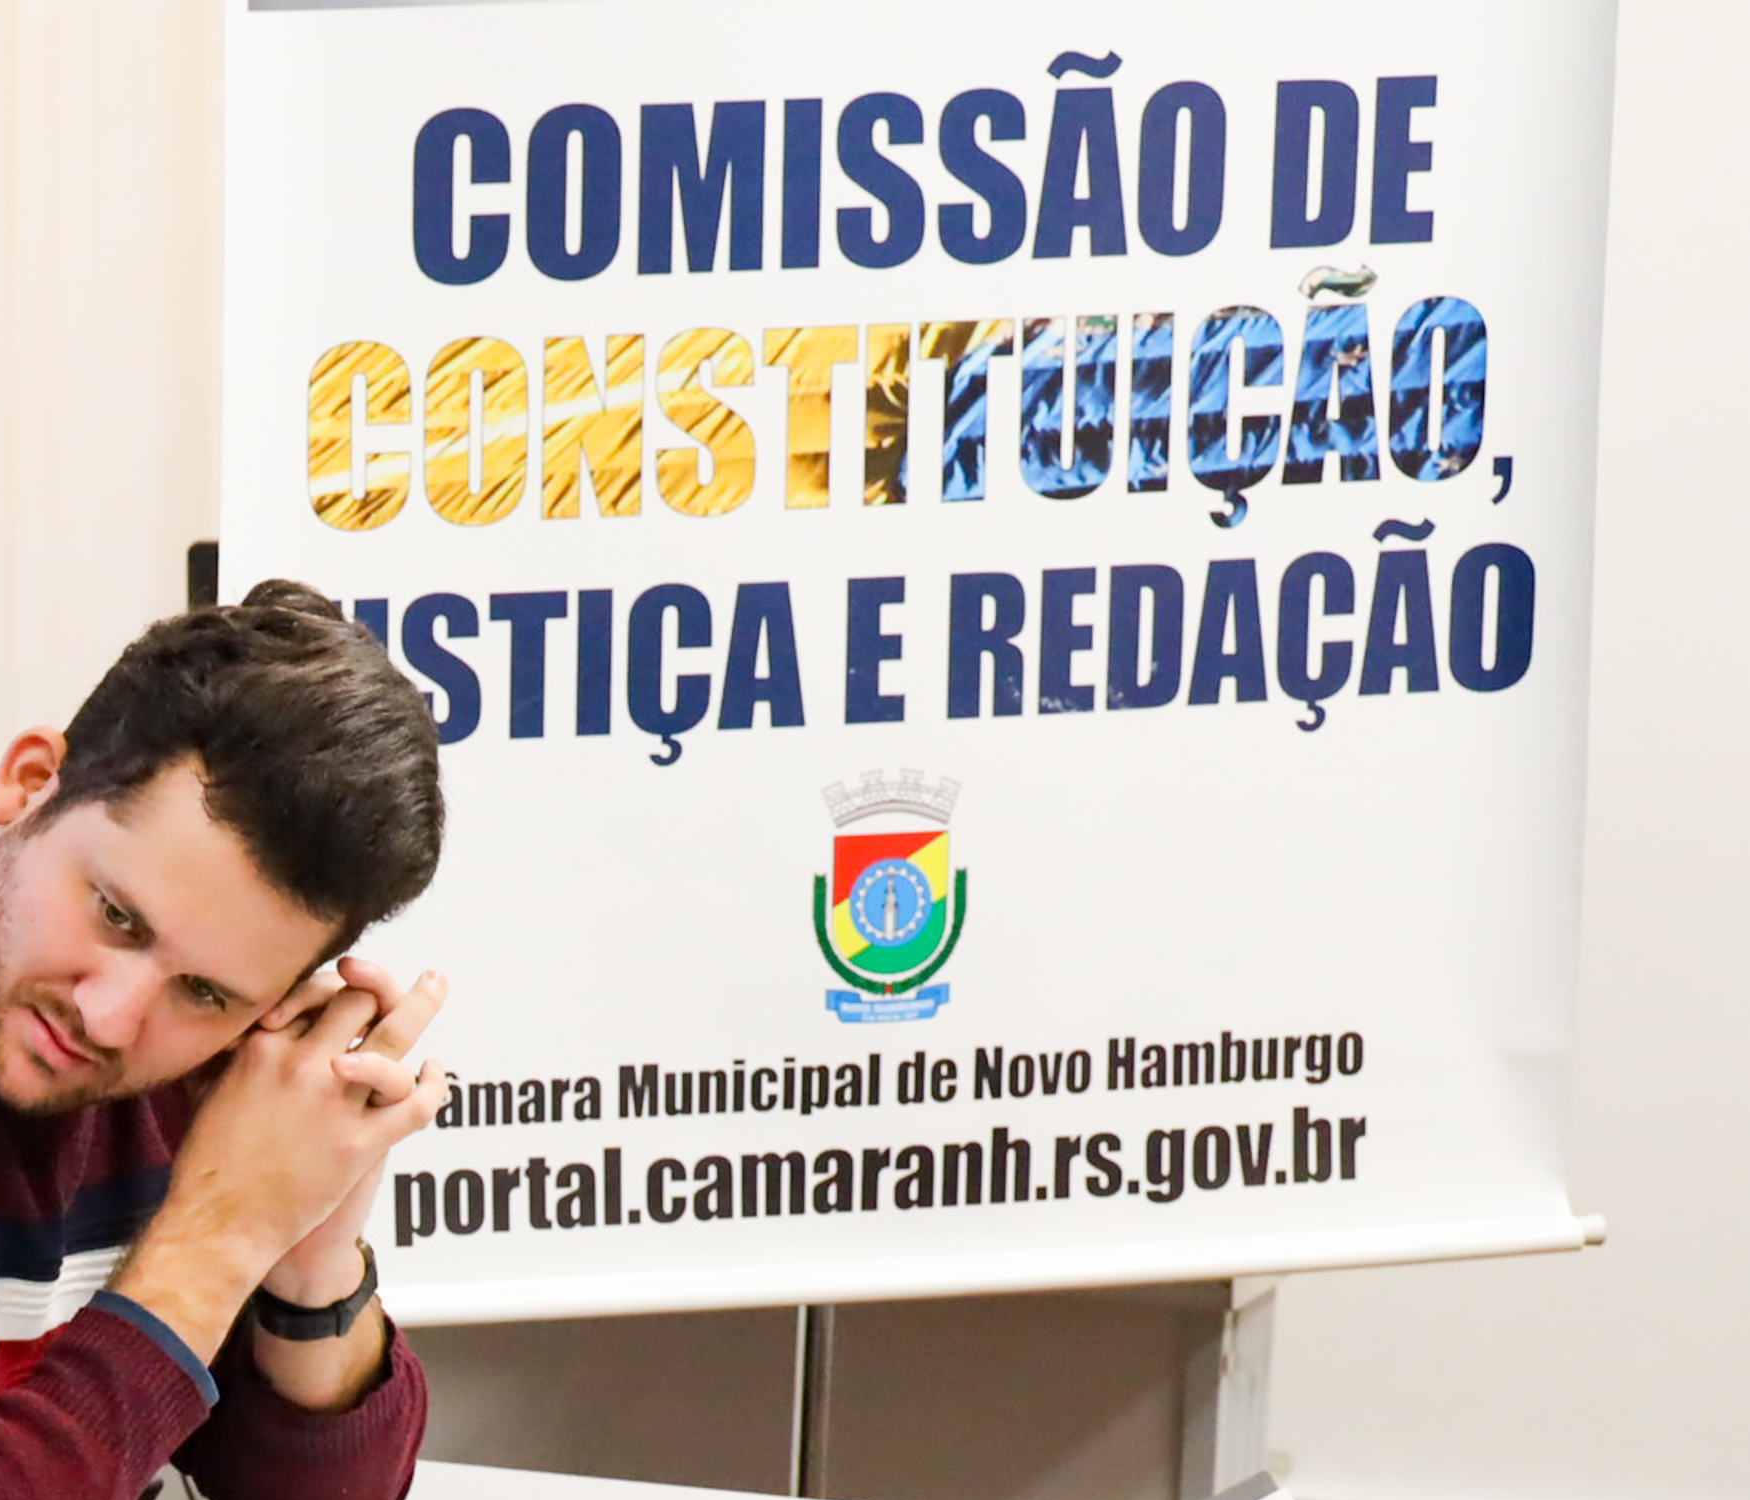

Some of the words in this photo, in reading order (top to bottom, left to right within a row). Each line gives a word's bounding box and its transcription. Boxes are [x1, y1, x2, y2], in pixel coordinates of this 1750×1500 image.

[412, 51, 1227, 286] COMISSÃO
[1269, 75, 1438, 249] DE
[307, 264, 1514, 531] CONSTITUIÇÃO,
[332, 581, 806, 767] STIÇA
[844, 576, 906, 725] E
[946, 518, 1536, 732] REDAÇÃO
[394, 1106, 1366, 1247] portal.camaranh.rs.gov.br
[416, 1072, 602, 1130] âmara
[618, 1053, 881, 1119] Municipal
[897, 1051, 958, 1105] de
[973, 1046, 1092, 1100] Novo
[1107, 1031, 1364, 1091] Hamburgo
